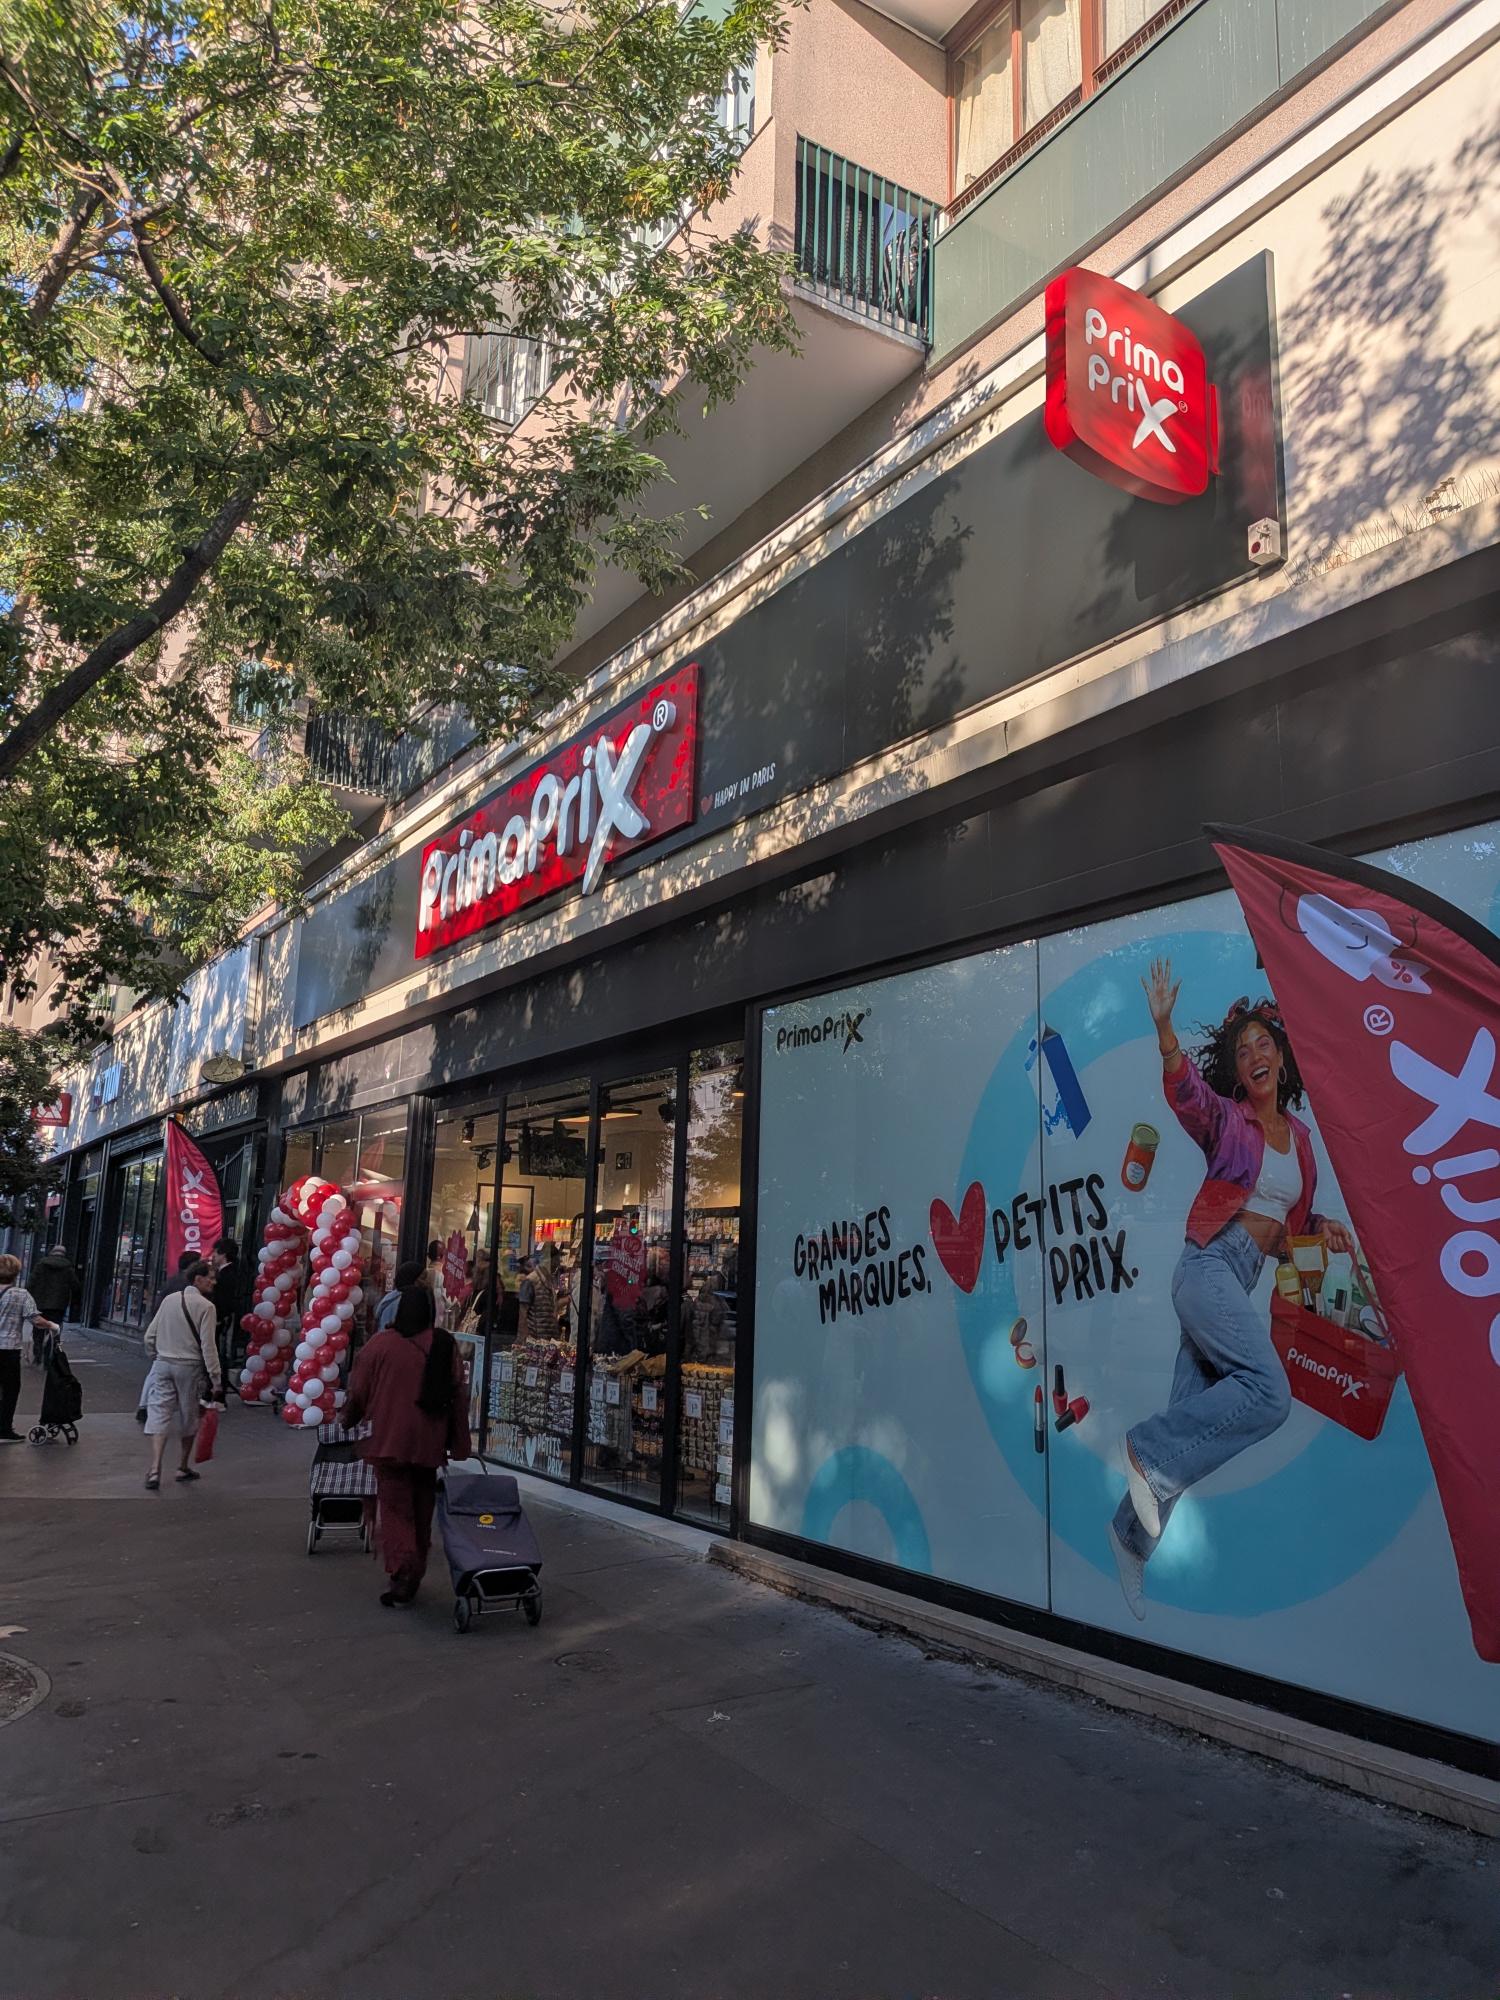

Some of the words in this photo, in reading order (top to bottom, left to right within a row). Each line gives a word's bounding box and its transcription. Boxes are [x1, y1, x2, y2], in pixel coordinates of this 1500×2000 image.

[1085, 308, 1185, 395] Prima
[714, 782, 738, 809] HAPPY
[740, 776, 750, 796] IN
[752, 762, 776, 790] PARIS
[794, 1205, 891, 1281] GRANDES
[992, 1173, 1109, 1264] PETITS
[818, 1244, 932, 1325] MARQUES,
[1049, 1229, 1139, 1304] PRIX.
